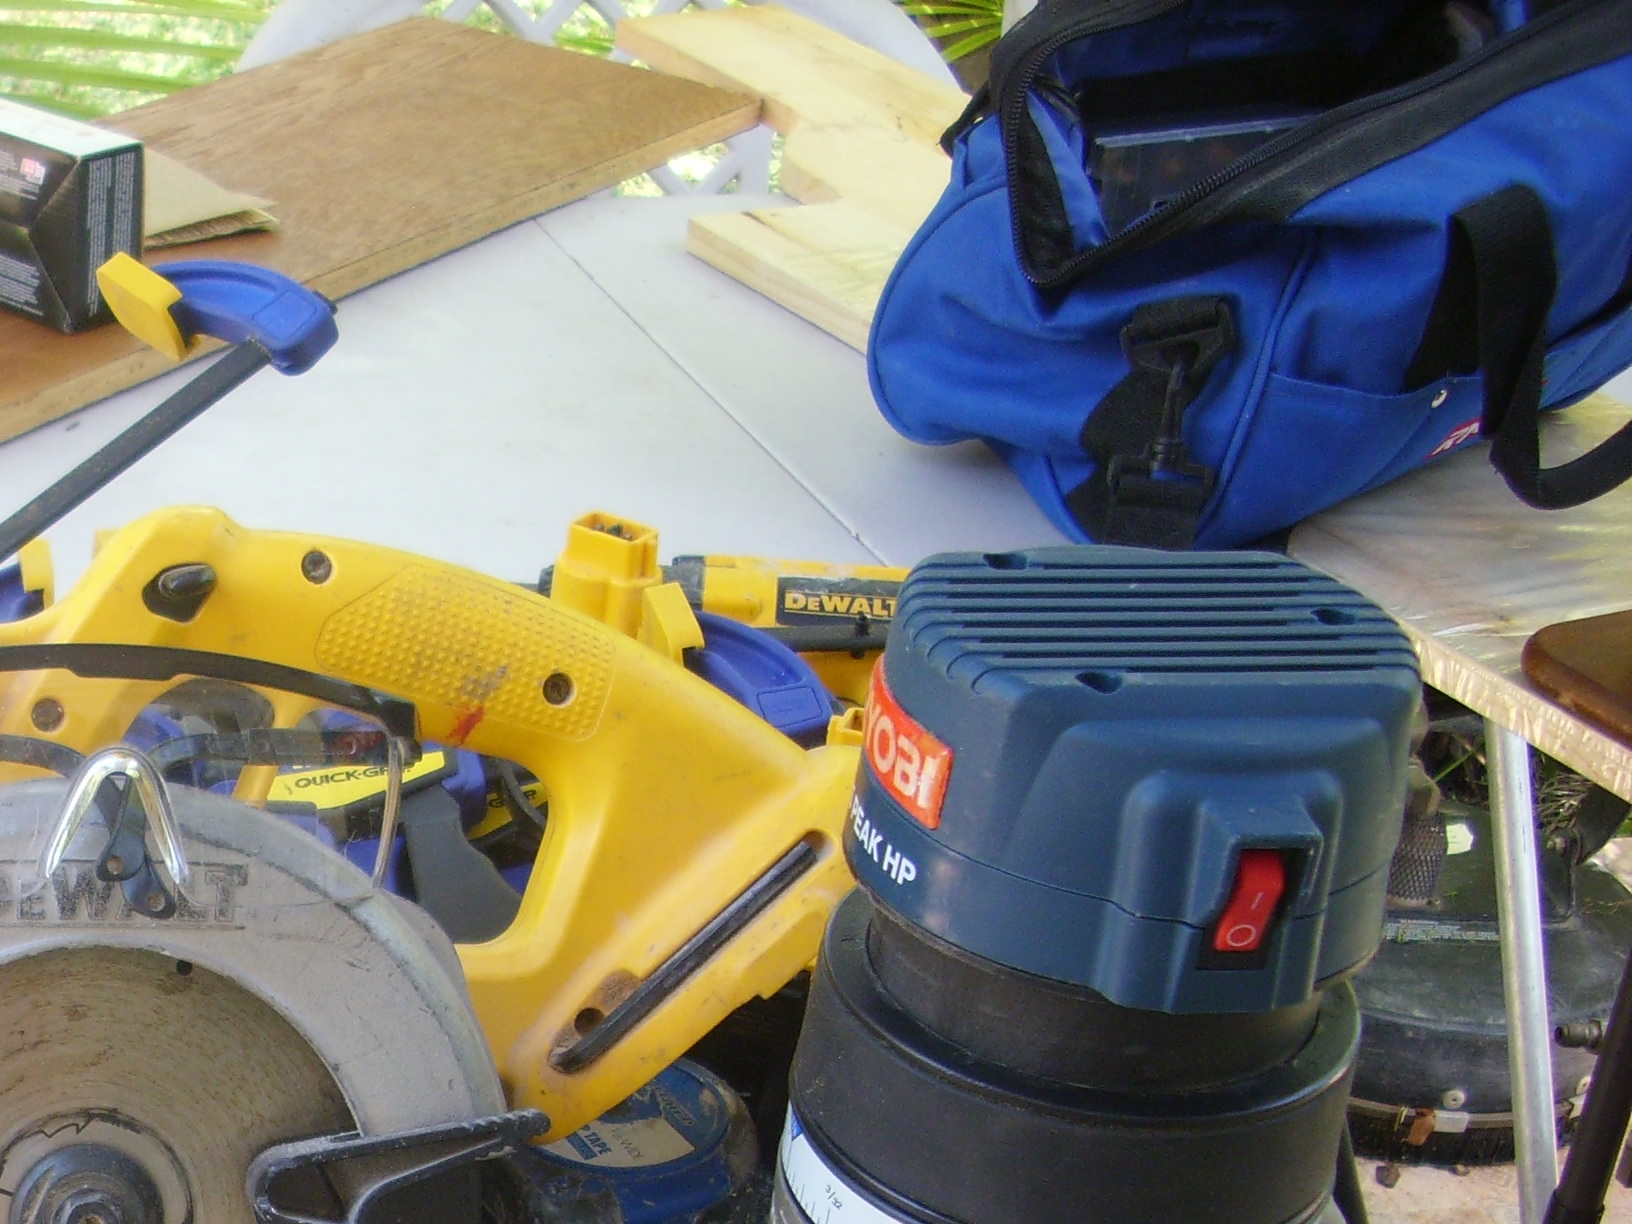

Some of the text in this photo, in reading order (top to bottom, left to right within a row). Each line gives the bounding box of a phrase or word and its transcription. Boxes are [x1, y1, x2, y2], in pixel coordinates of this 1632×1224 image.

[865, 688, 941, 809] YOBI
[850, 796, 917, 885] PEAK HP
[583, 1131, 613, 1156] TAPE
